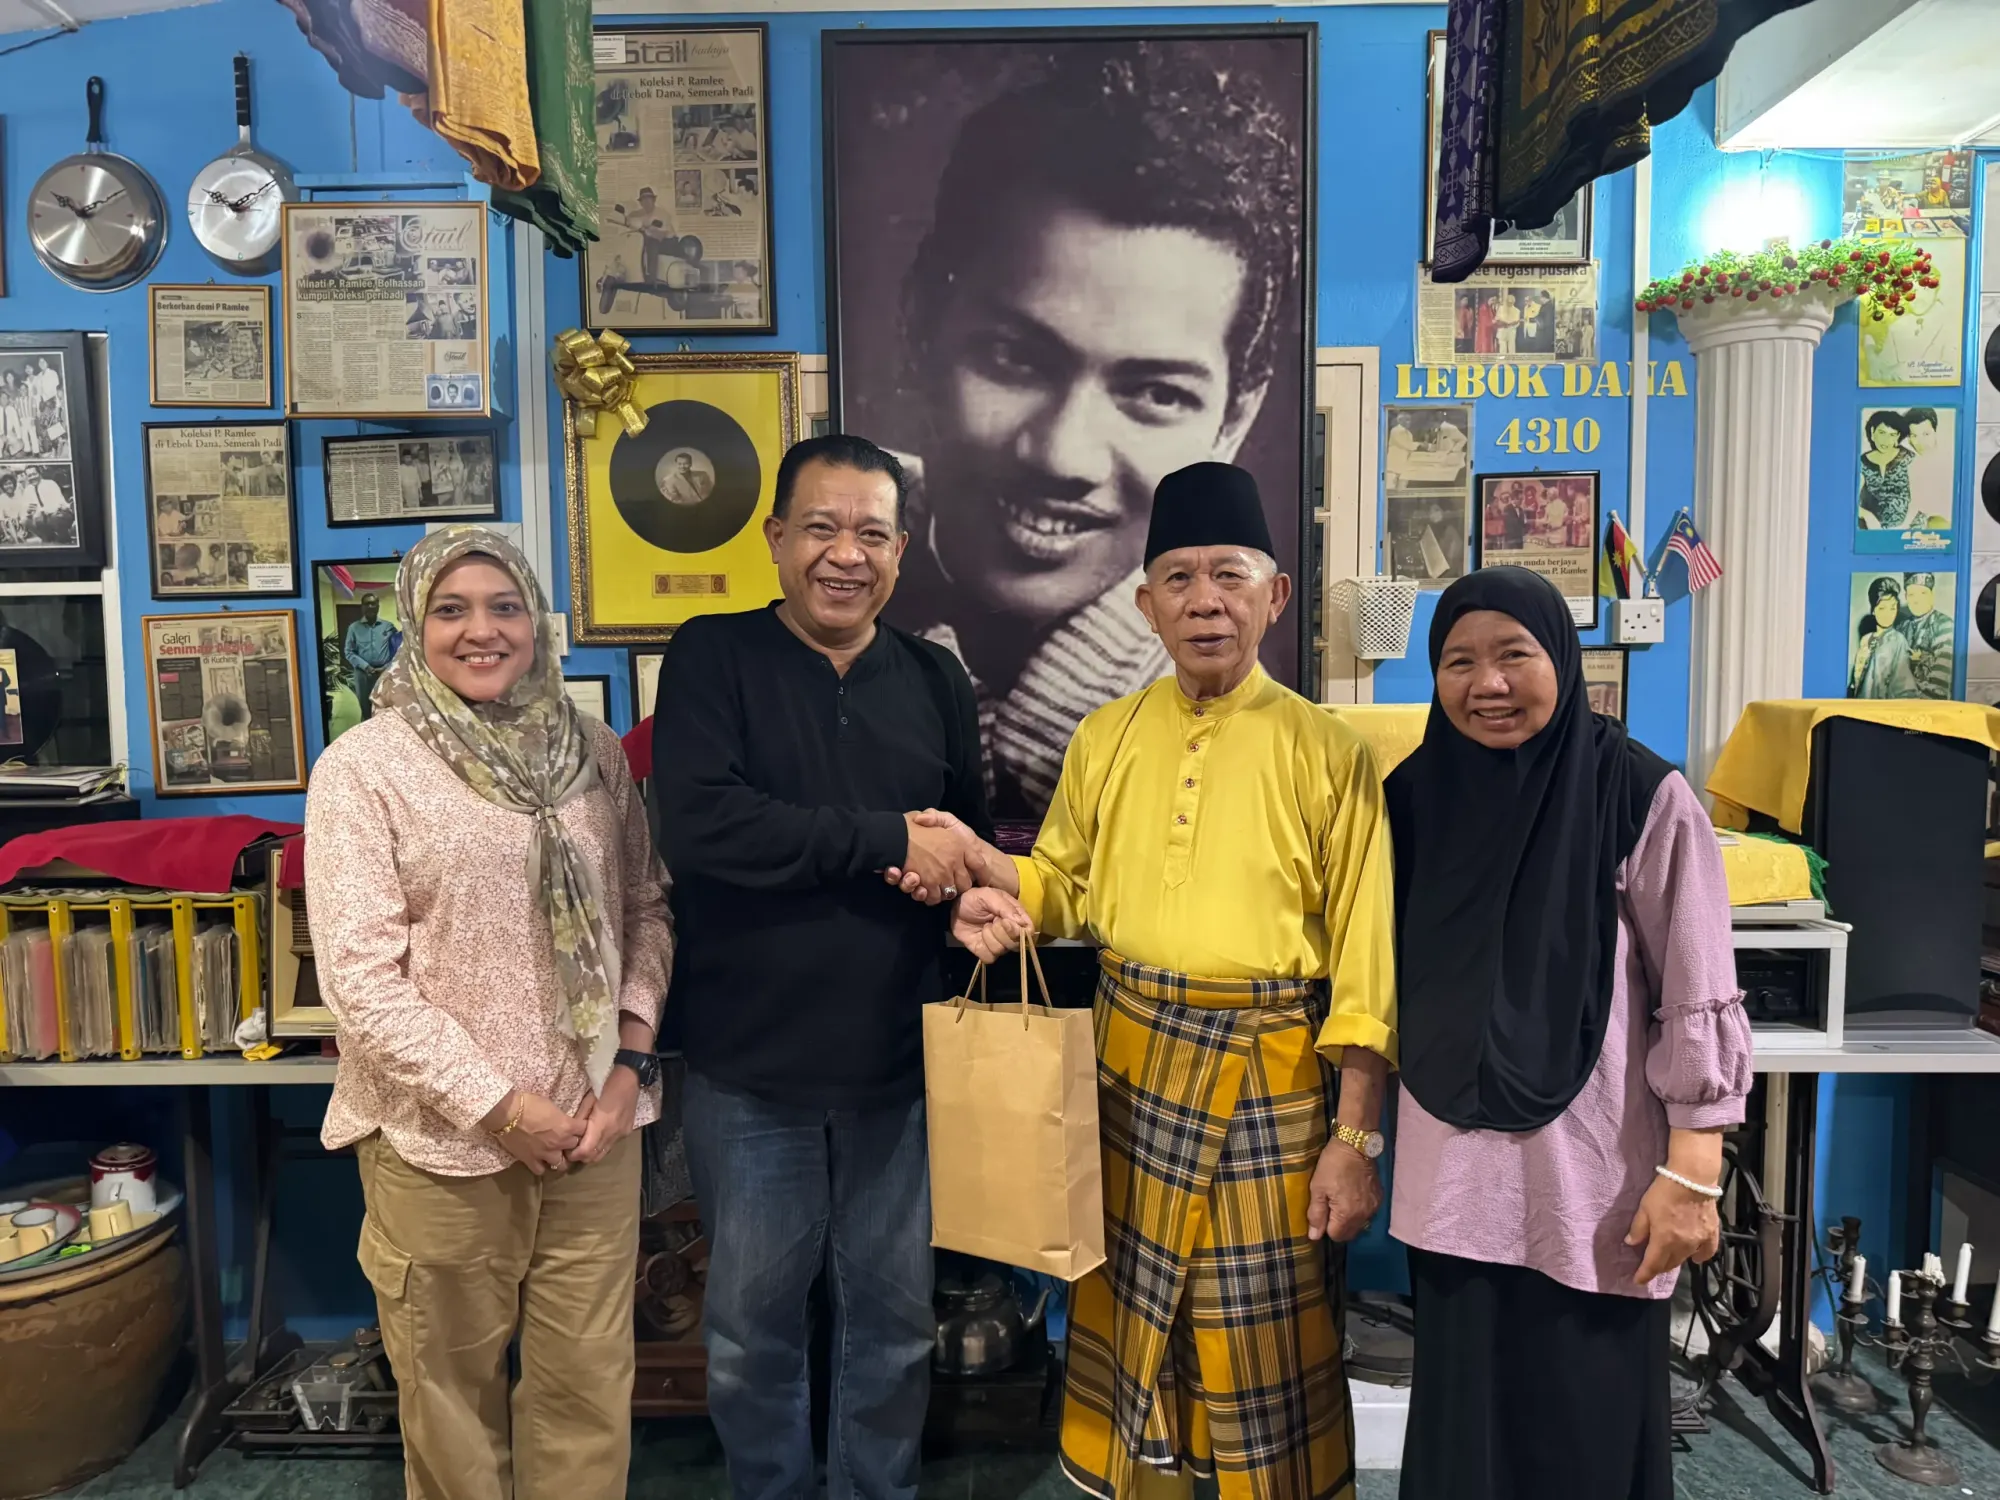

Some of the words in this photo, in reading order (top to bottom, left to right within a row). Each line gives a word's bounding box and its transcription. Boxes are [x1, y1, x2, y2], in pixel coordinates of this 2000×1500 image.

[639, 76, 674, 87] Koleksi
[677, 76, 685, 86] P.
[688, 75, 725, 86] Ramlee
[656, 88, 684, 99] Dana,
[687, 86, 729, 98] Semerah
[732, 86, 754, 97] Padi
[296, 279, 327, 289] Minati
[329, 279, 338, 289] P.
[377, 278, 424, 289] Bolhassan
[296, 291, 332, 302] kumpul
[333, 291, 365, 301] koleksi
[366, 290, 404, 302] peribadi
[157, 302, 195, 311] Berkorban
[196, 303, 215, 311] demi
[216, 303, 221, 311] P
[222, 303, 250, 311] Ramlee
[1394, 363, 1550, 399] LEBOK
[180, 429, 212, 439] Koleksi
[214, 429, 221, 438] P.
[224, 428, 256, 438] Ramlee
[1495, 417, 1601, 454] 4310
[155, 440, 164, 449] di
[166, 439, 193, 449] Lebok
[223, 438, 260, 448] Semerah
[263, 438, 282, 447] Padi
[1523, 559, 1545, 567] muda
[1547, 558, 1577, 568] berjaya
[1560, 567, 1588, 575] Ramlee
[162, 631, 191, 645] Galeri
[203, 656, 210, 665] di
[211, 655, 238, 665] Kuching
